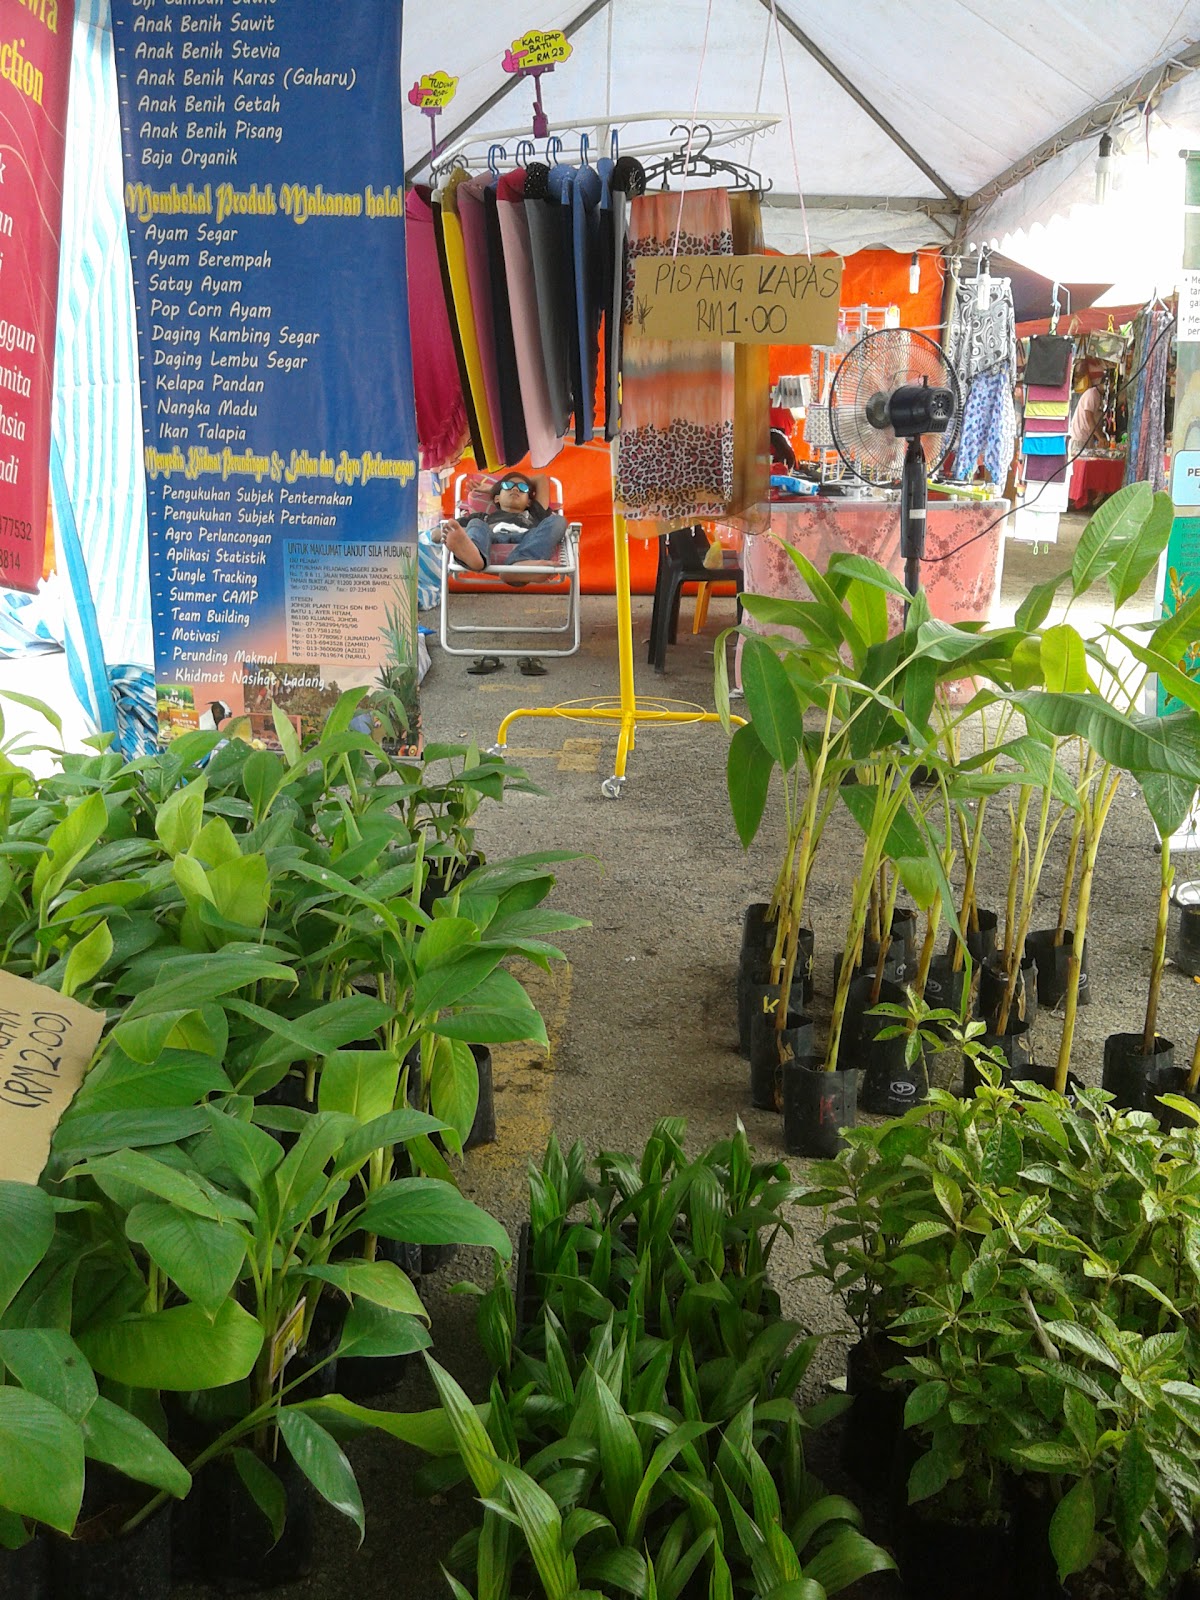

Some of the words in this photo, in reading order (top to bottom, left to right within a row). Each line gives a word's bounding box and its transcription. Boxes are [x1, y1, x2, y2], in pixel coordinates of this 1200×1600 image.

[134, 15, 172, 32] Anak
[181, 14, 221, 32] Benih
[230, 13, 275, 31] Sawit
[135, 42, 173, 59] Anak
[182, 41, 222, 59] Benih
[231, 40, 280, 58] Stevia
[0, 38, 43, 107] ction
[136, 69, 175, 85] Anak
[183, 68, 224, 85] Benih
[233, 68, 275, 85] Karas
[283, 68, 356, 90] (Gaharu)
[138, 95, 176, 112] Anak
[185, 94, 225, 112] Benih
[234, 95, 280, 112] Getah
[140, 122, 178, 138] Anak
[186, 121, 226, 138] Benih
[235, 120, 283, 143] Pisang
[142, 148, 172, 169] Baja
[181, 148, 237, 169] Organik
[125, 182, 211, 222] Membekal
[215, 183, 277, 223] Produk
[280, 183, 360, 224] Makanan
[366, 185, 403, 218] halal
[145, 224, 188, 244] Ayam
[197, 224, 237, 245] Segar
[147, 250, 189, 269] Ayam
[198, 250, 271, 271] Berempah
[148, 274, 192, 295] Satay
[201, 275, 242, 295] Ayam
[655, 261, 745, 294] PISANG
[758, 264, 839, 299] KAPAS
[151, 299, 180, 320] Pop
[188, 301, 221, 317] Corn
[230, 301, 271, 321] Ayam
[697, 298, 788, 335] RM1.00
[152, 325, 200, 345] Daging
[210, 326, 270, 347] Kambing
[279, 326, 319, 348] Segar
[153, 350, 202, 370] Daging
[210, 351, 258, 367] Lembu
[267, 351, 307, 372] Segar
[156, 374, 204, 394] Kelapa
[213, 374, 264, 392] Pandan
[157, 399, 210, 418] Nangka
[218, 399, 257, 416] Madu
[160, 423, 188, 438] Ikan
[197, 423, 246, 443] Talapia
[163, 485, 230, 503] Pengukuhan
[236, 488, 273, 503] Subjek
[280, 489, 352, 506] Penternakan
[164, 505, 231, 522] Pengukuhan
[238, 508, 274, 526] Subjek
[280, 510, 336, 526] Pertanian
[0, 516, 32, 541] 77532
[165, 527, 192, 544] Agro
[199, 529, 272, 546] Perlancongan
[167, 549, 209, 565] Aplikasi
[216, 550, 266, 564] Statistik
[288, 543, 308, 554] UNTUK
[310, 544, 341, 556] MAKLUMAT
[344, 545, 366, 556] LANJUT
[368, 545, 382, 557] SILA
[384, 546, 411, 558] HUBUNGI
[168, 568, 206, 585] Jungle
[212, 570, 257, 587] Tracking
[170, 588, 217, 602] Summer
[223, 590, 258, 604] CAMP
[171, 608, 200, 621] Team
[207, 610, 250, 627] Building
[172, 628, 220, 642] Motivasi
[173, 647, 228, 665] Perunding
[234, 650, 277, 664] Makmal
[175, 669, 225, 683] Khidmat
[232, 672, 276, 686] Nasihat
[283, 675, 325, 691] Ladang
